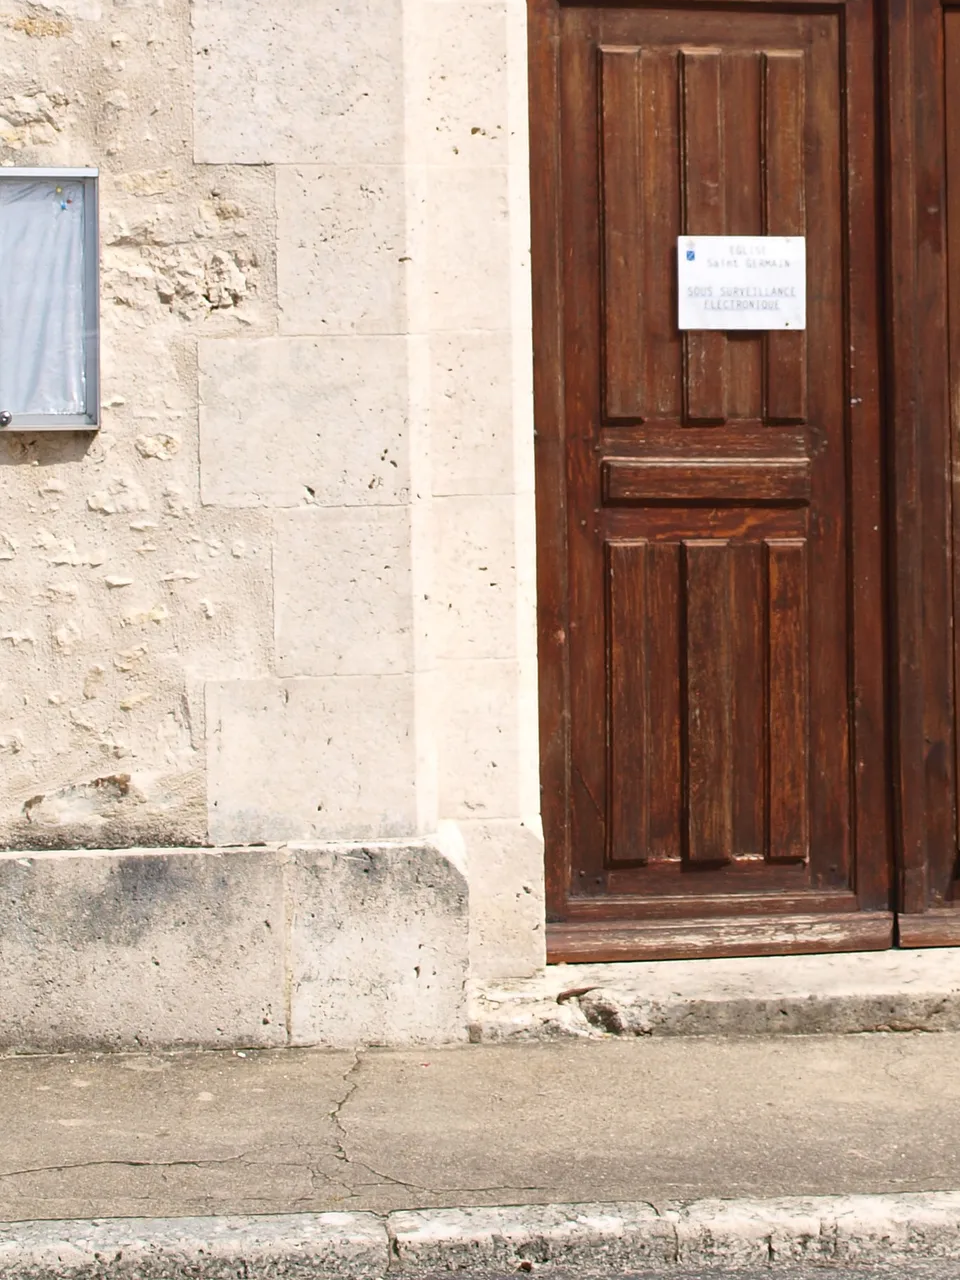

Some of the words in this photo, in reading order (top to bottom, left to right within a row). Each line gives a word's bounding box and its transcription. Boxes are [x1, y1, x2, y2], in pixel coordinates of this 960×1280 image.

[707, 258, 739, 268] Saint
[746, 258, 790, 268] GERMAIN
[687, 286, 713, 297] SOUS
[720, 286, 796, 297] SURVEILLANCE
